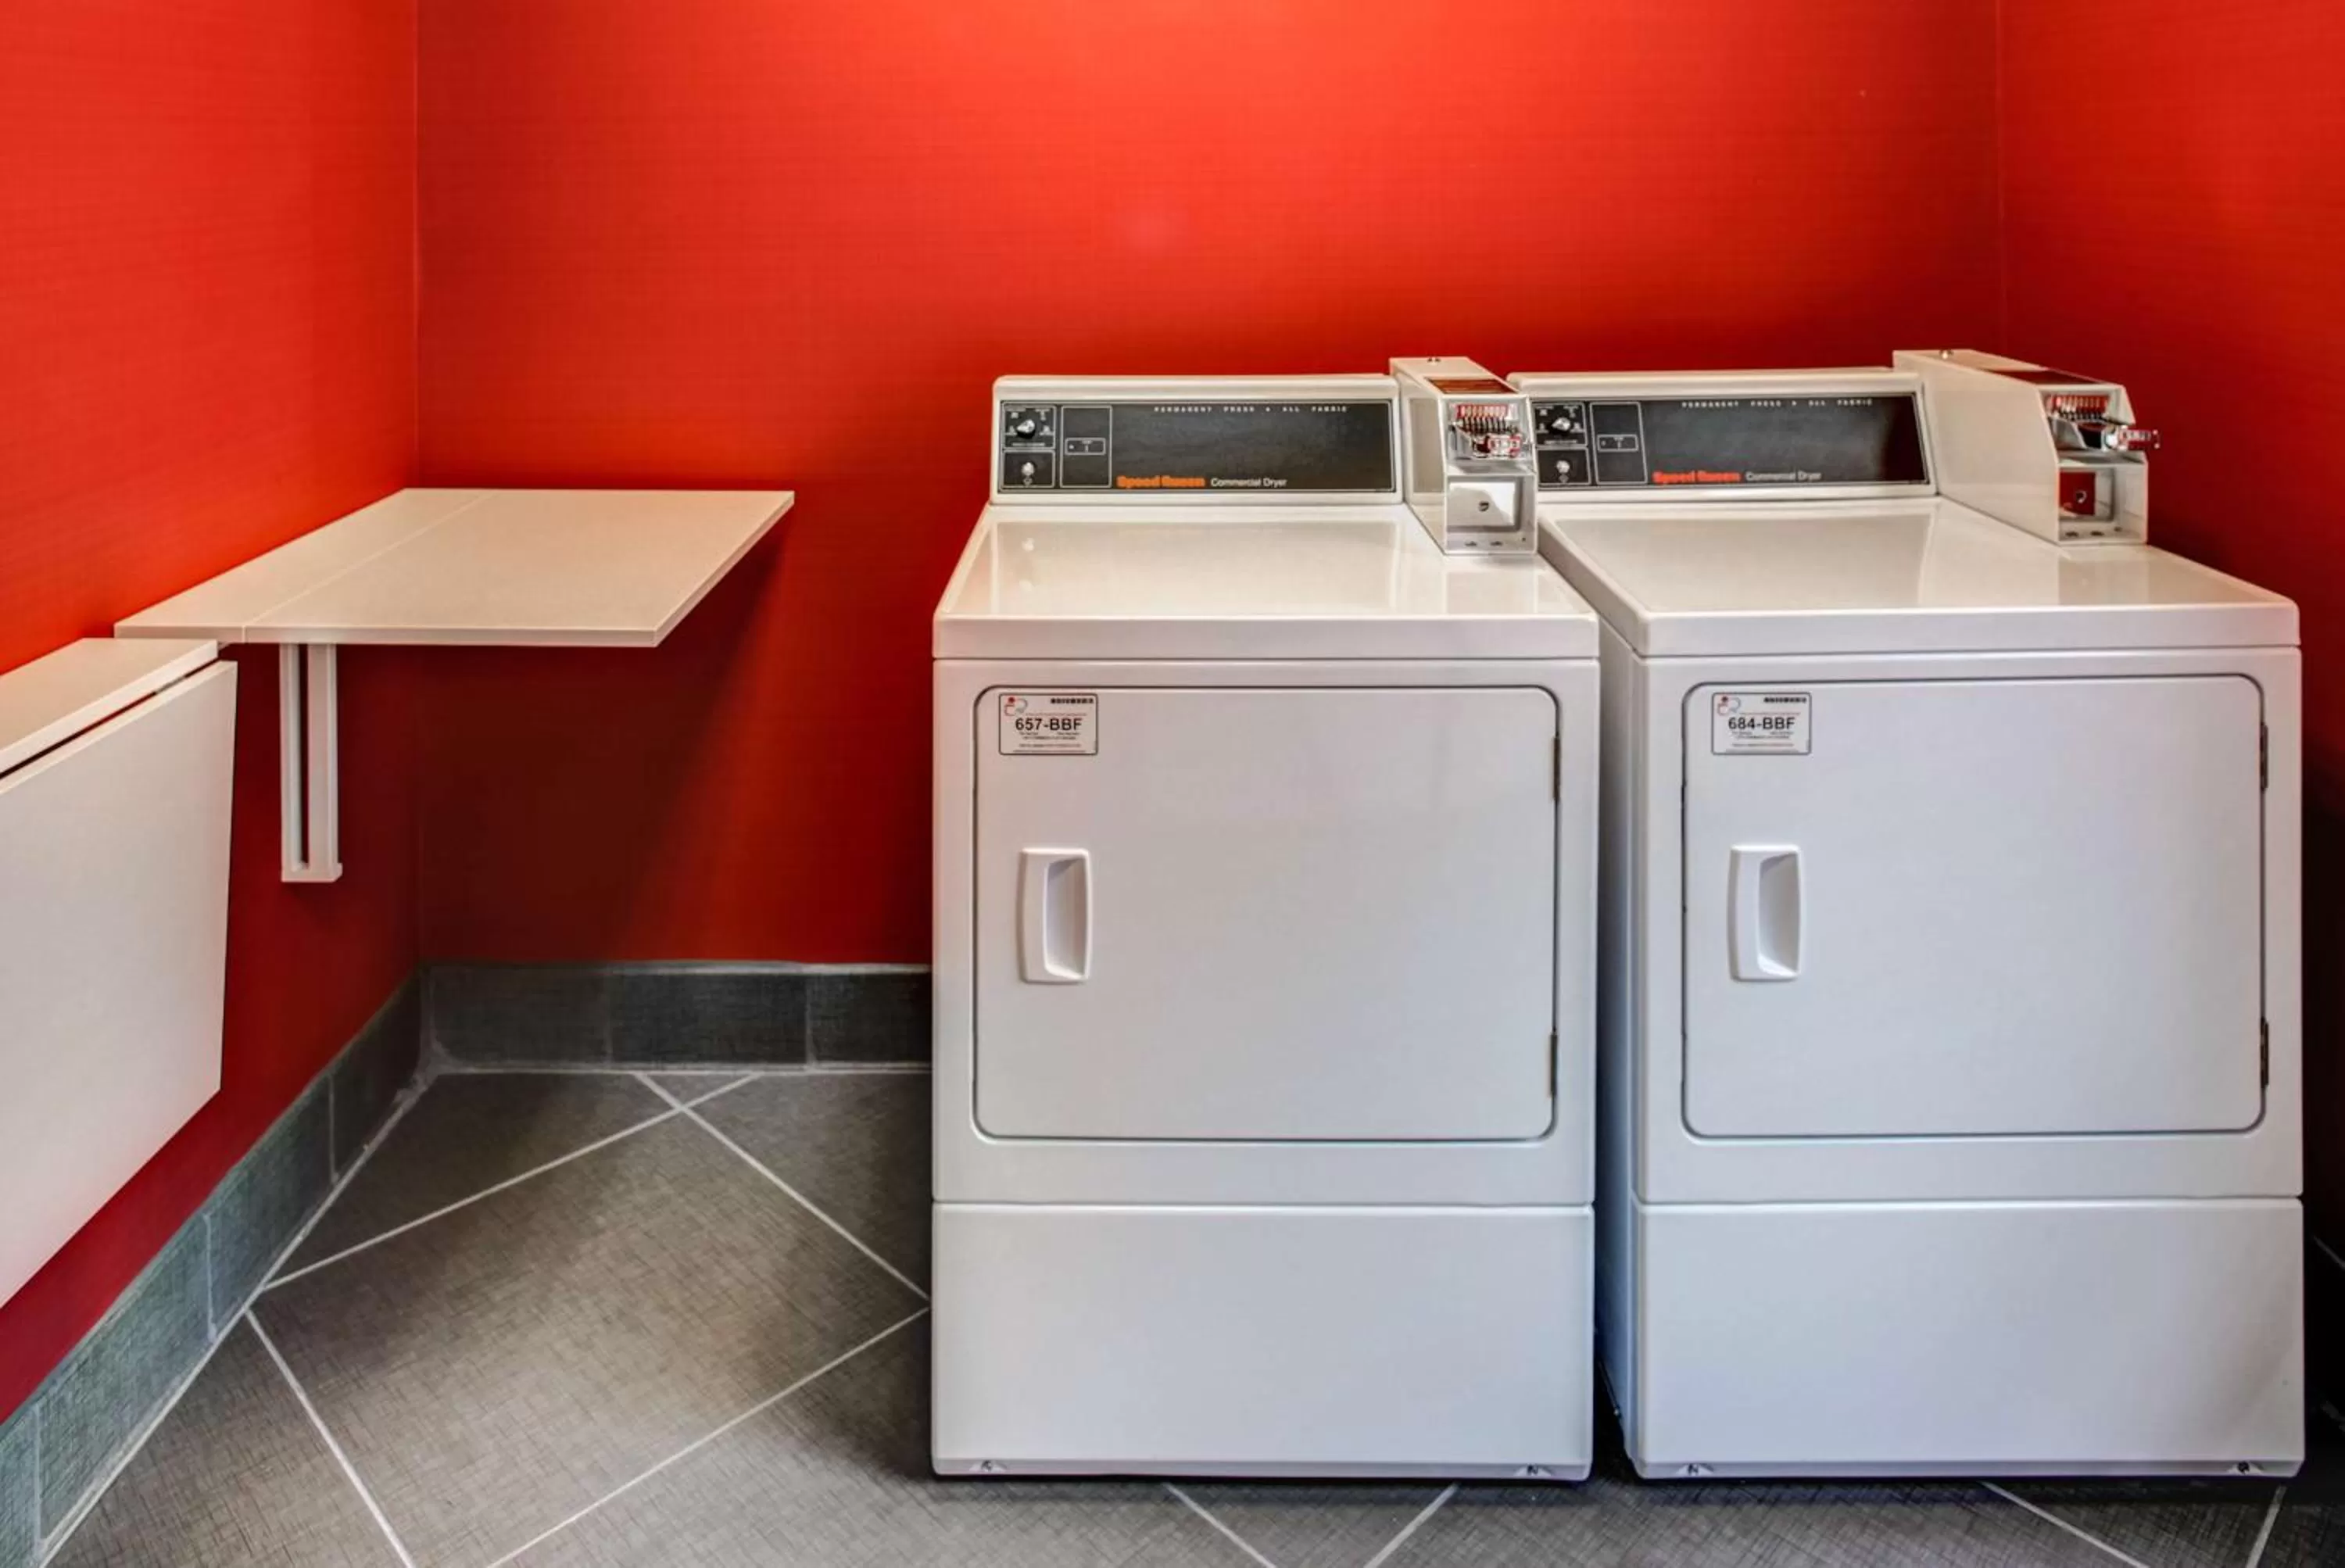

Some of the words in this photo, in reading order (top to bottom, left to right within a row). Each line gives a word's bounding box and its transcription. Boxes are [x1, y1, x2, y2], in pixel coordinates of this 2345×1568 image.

[1211, 477, 1262, 487] Commercial
[1262, 477, 1287, 489] Dryer
[1015, 717, 1083, 731] 657-BBF
[1727, 717, 1795, 730] 684-BBF
